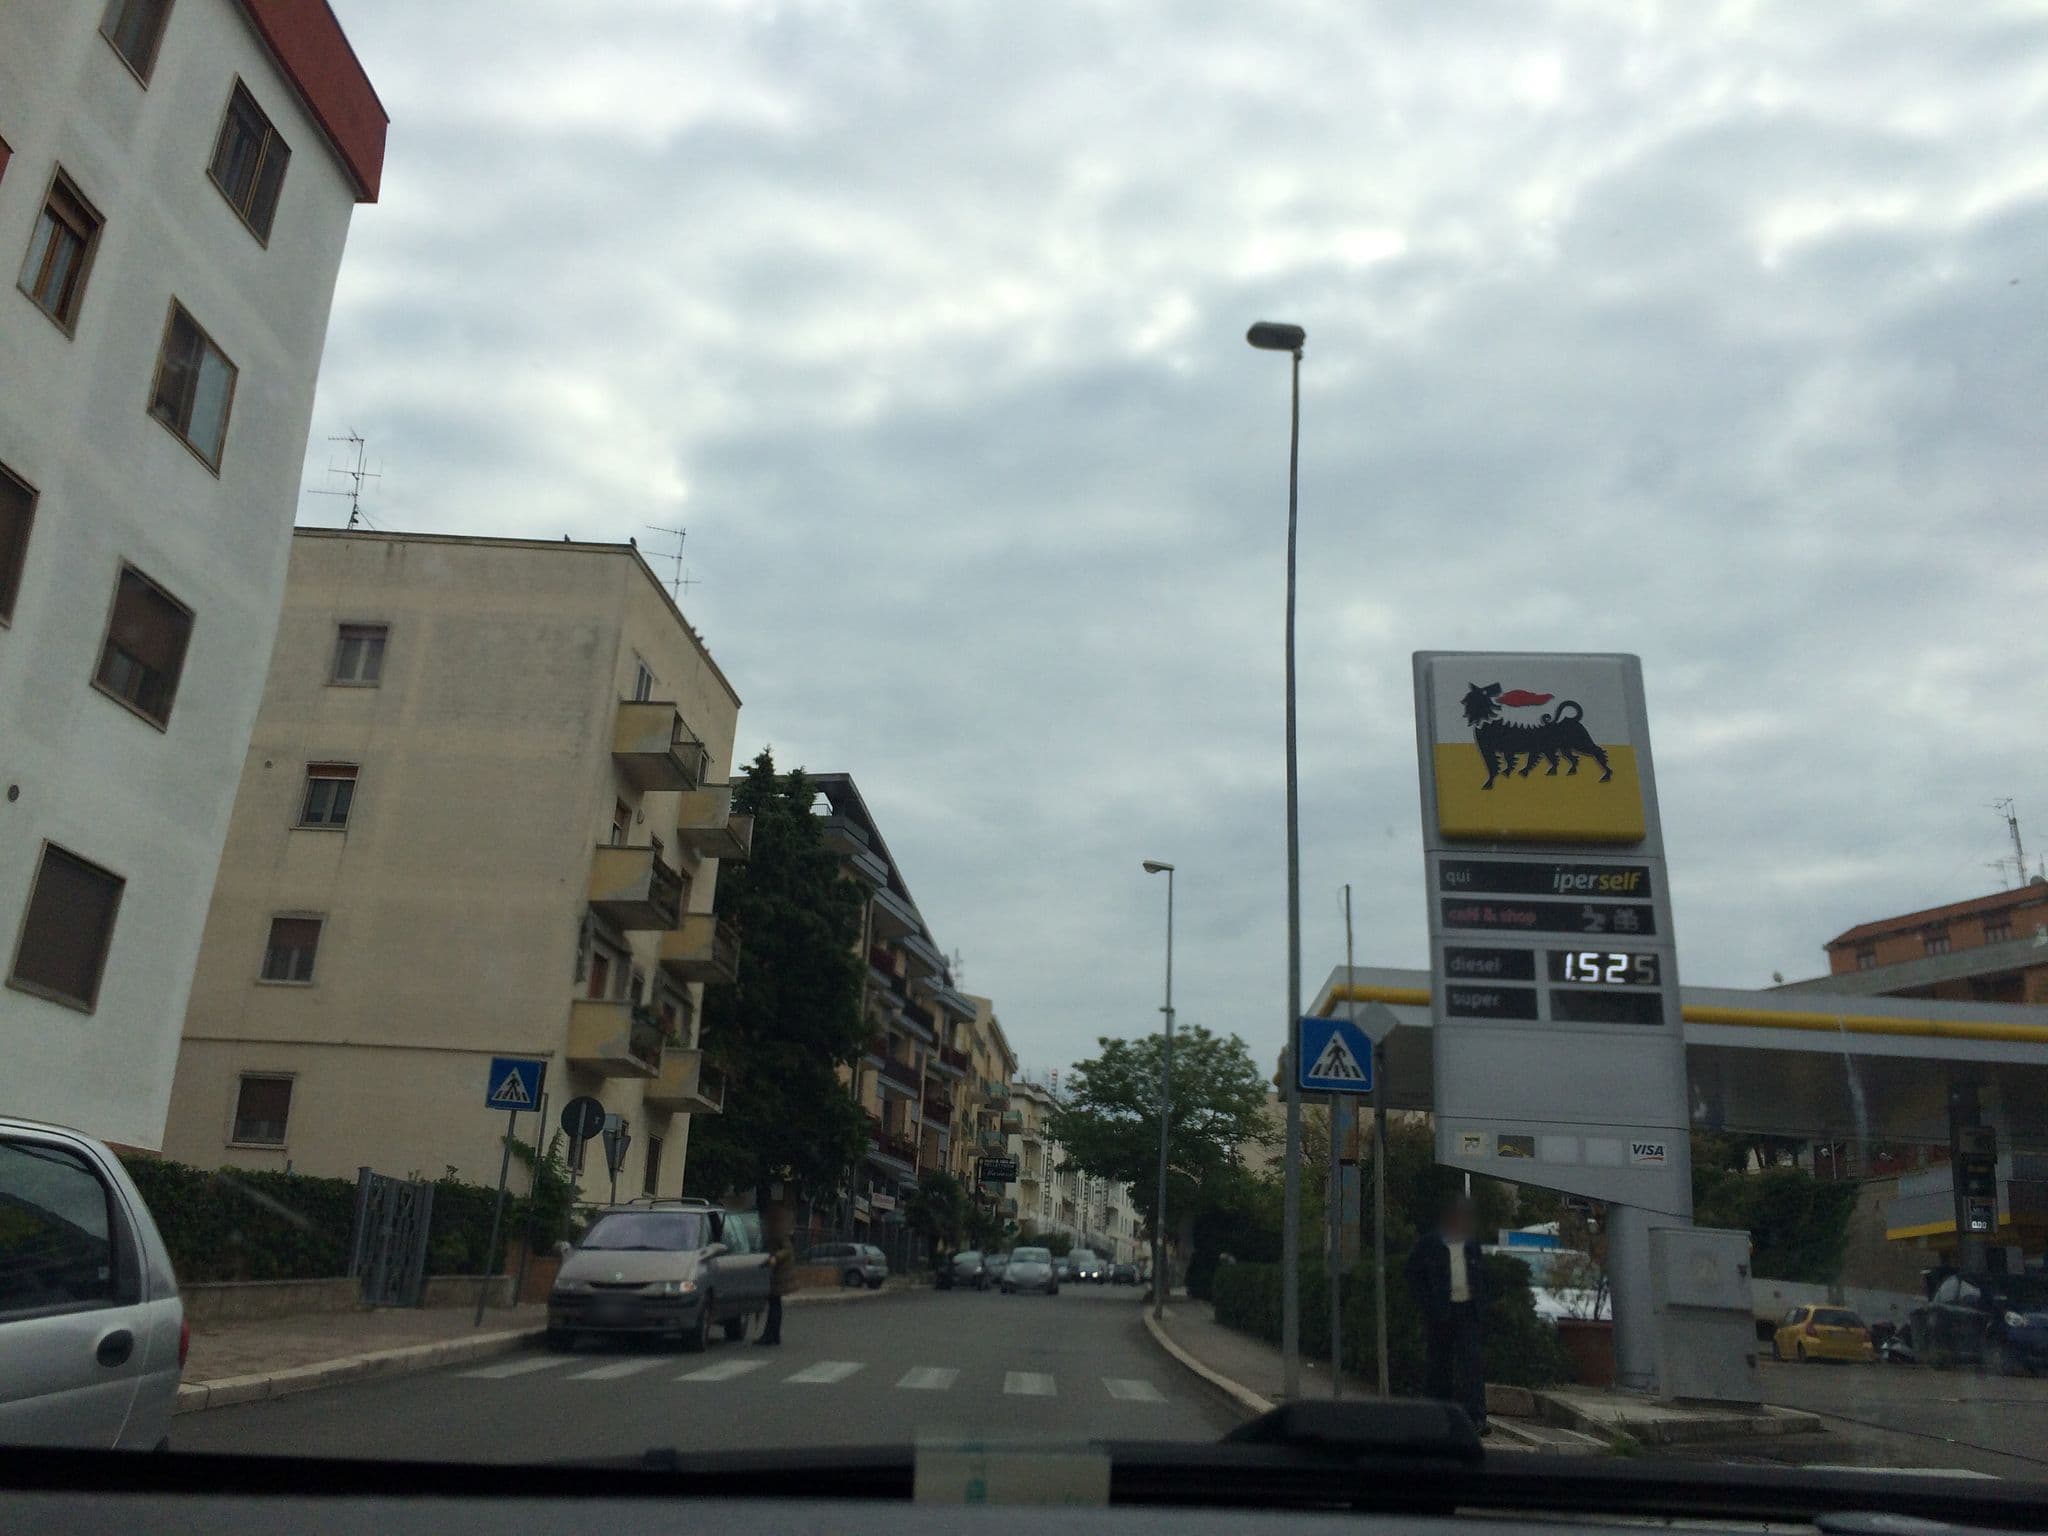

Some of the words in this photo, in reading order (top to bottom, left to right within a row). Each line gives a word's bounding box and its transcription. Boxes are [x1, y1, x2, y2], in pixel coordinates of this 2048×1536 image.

[1446, 869, 1472, 883] qui
[1552, 867, 1641, 892] iperself
[1450, 955, 1500, 972] diesel
[1452, 992, 1500, 1008] super
[1632, 1143, 1664, 1156] VISA
